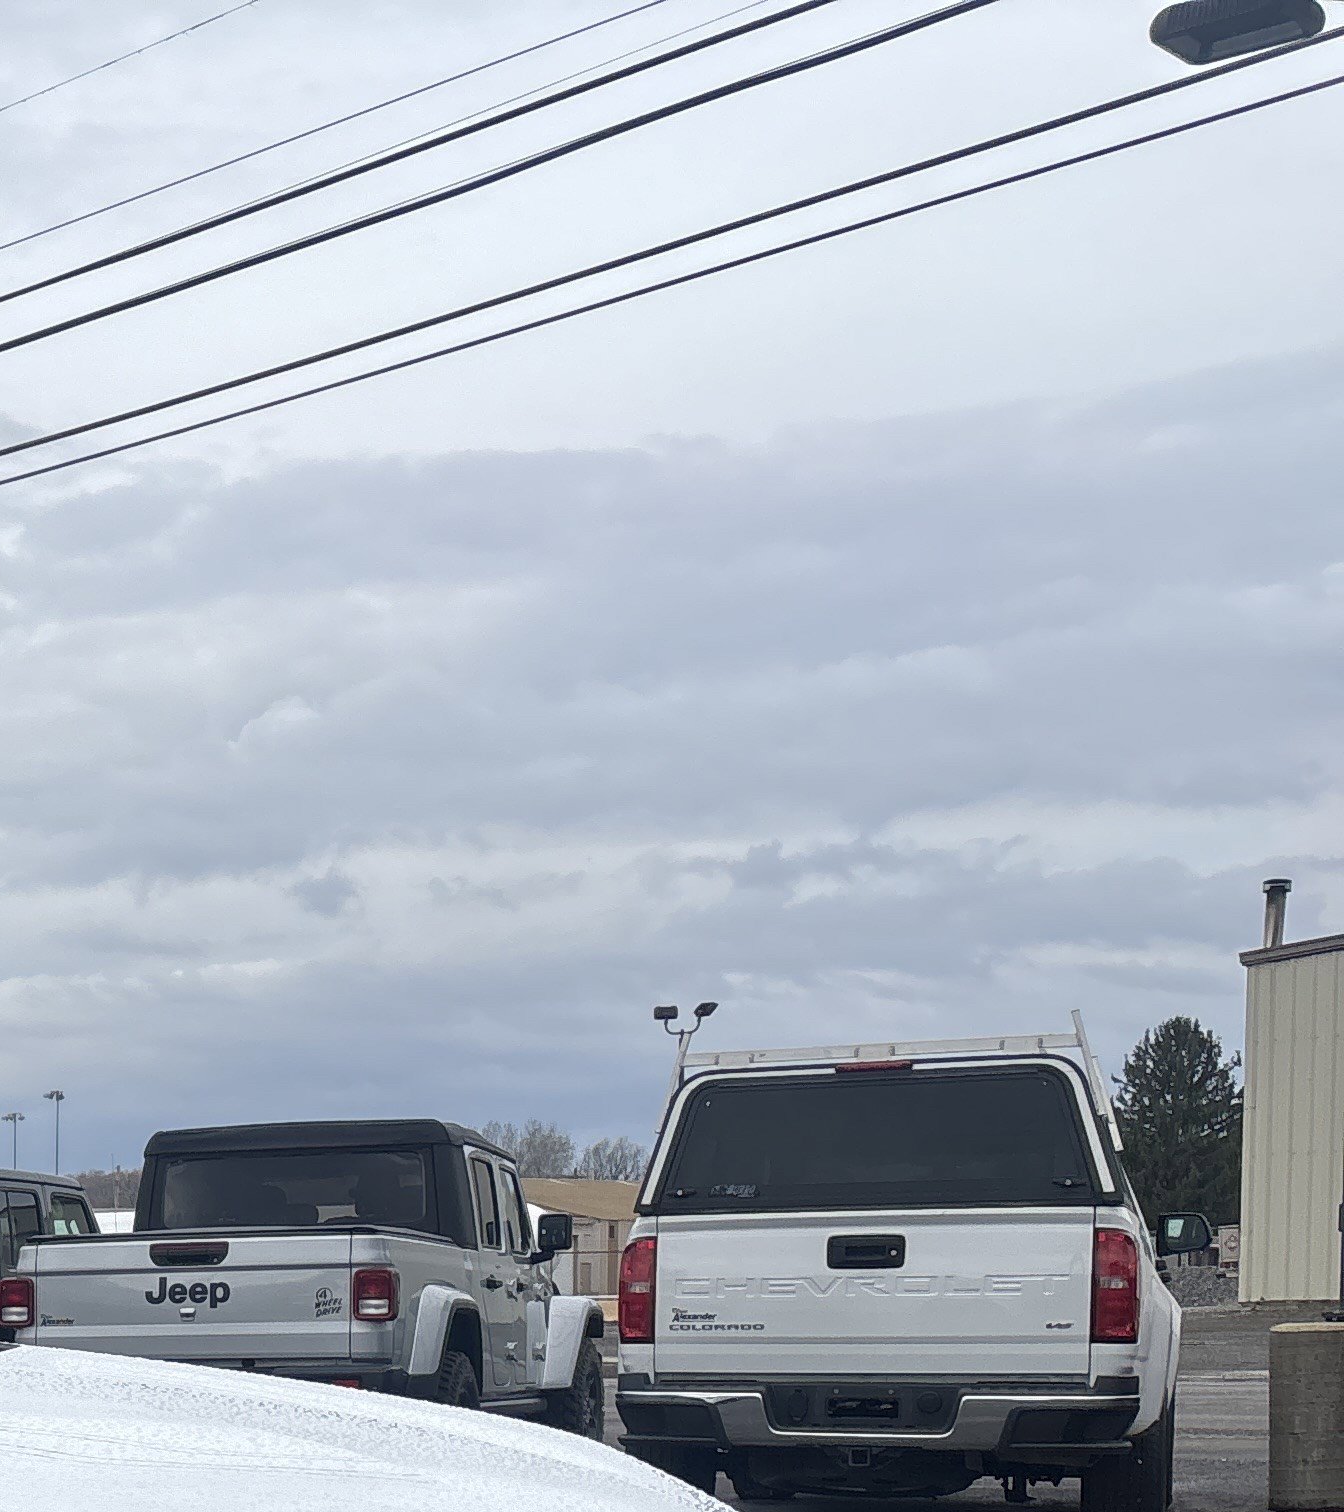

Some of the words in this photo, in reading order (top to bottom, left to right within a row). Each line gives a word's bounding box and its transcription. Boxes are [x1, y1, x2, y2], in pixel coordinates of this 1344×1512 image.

[145, 1276, 231, 1308] Jeep
[673, 1274, 1071, 1299] CHEVROLET
[315, 1305, 343, 1318] DRIVE
